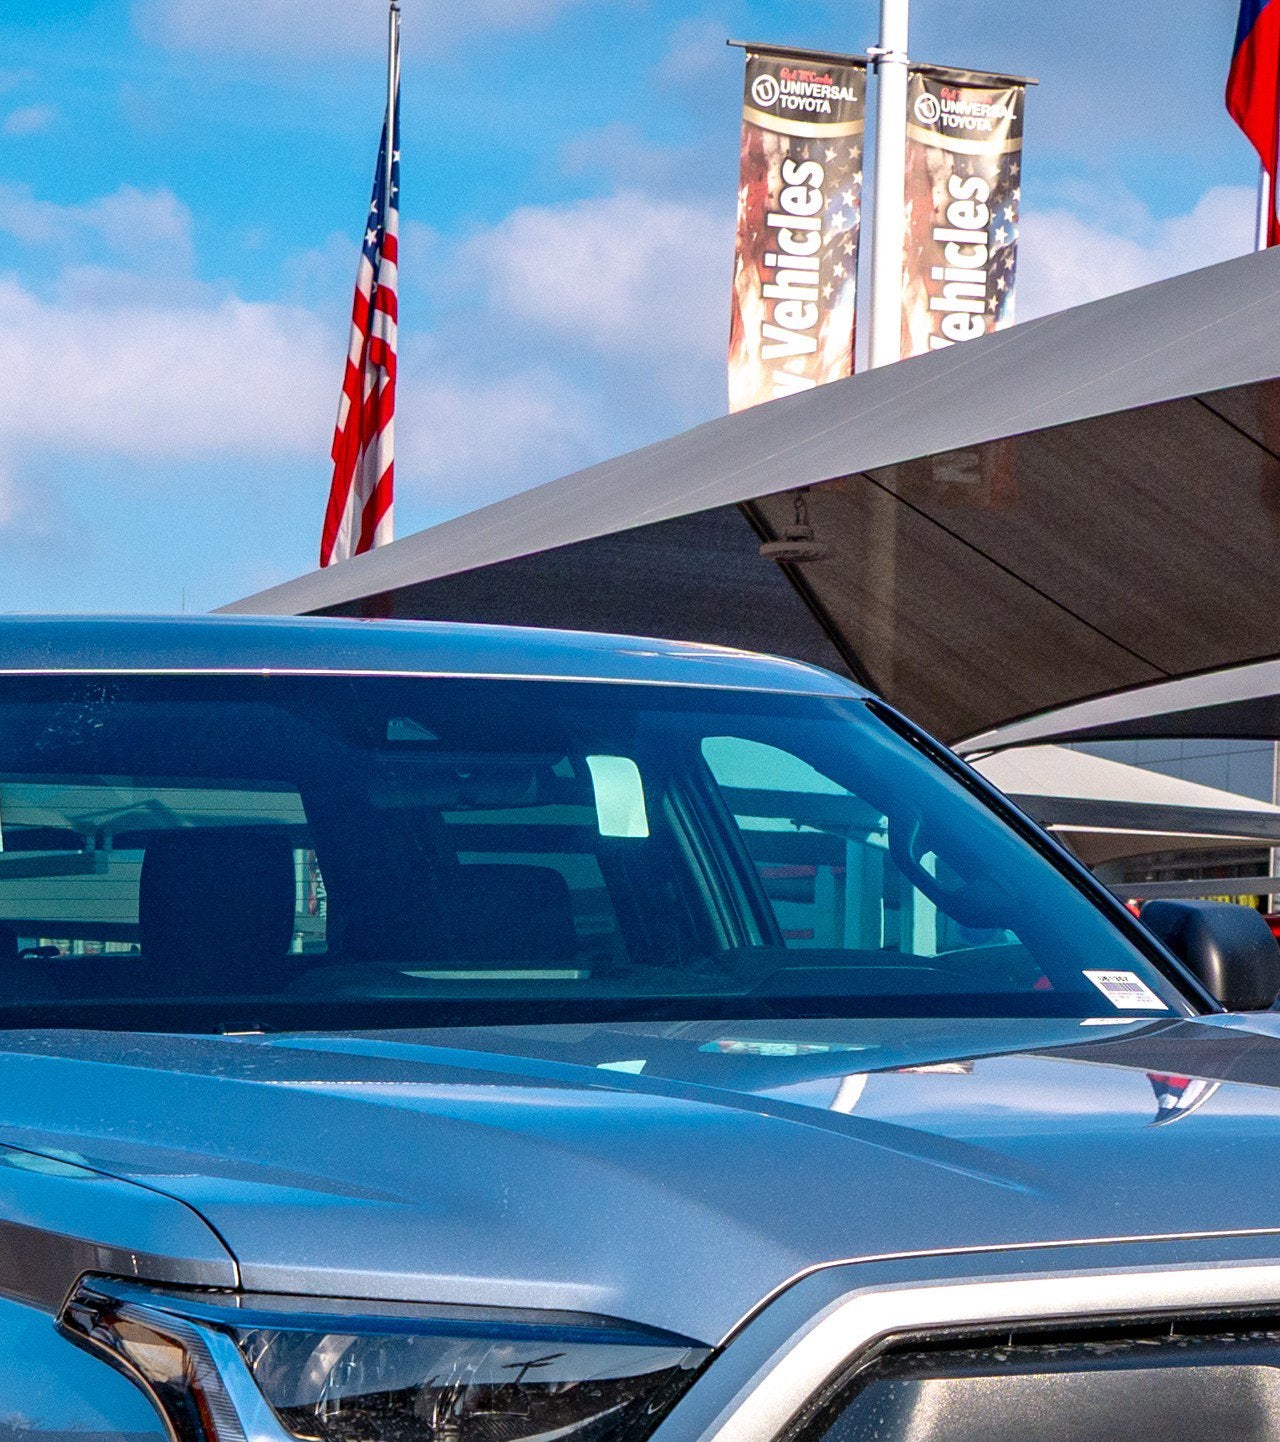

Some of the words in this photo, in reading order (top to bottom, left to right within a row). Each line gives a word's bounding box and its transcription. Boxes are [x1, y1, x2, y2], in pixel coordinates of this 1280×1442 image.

[780, 80, 858, 102] UNIVERSAL
[779, 94, 832, 114] TOYOTA
[941, 99, 1018, 120] UNIVERSAL
[941, 114, 993, 131] TOYOTA
[762, 159, 825, 360] Vehicles
